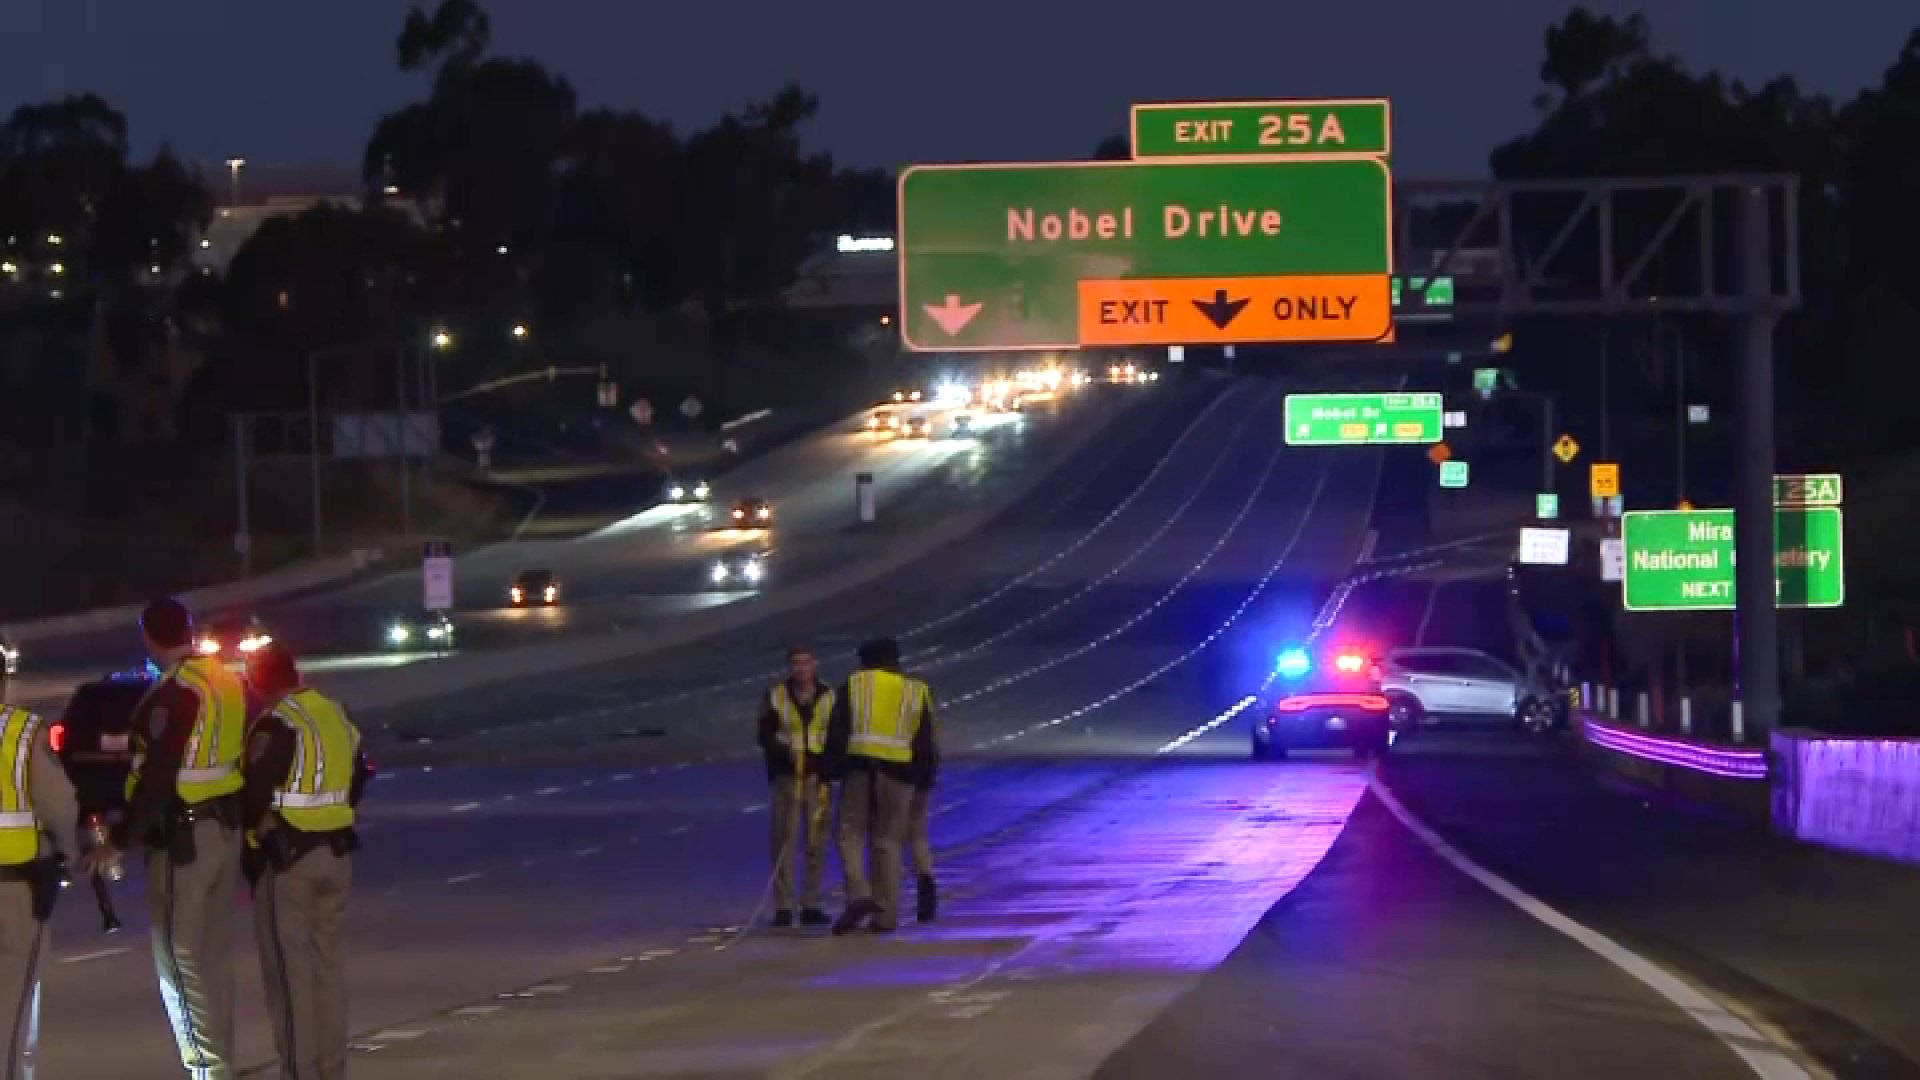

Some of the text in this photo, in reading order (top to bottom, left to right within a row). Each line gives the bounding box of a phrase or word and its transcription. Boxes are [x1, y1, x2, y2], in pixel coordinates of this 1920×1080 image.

[1175, 114, 1345, 145] EXIT 25A
[1007, 204, 1282, 241] Nobel Drive
[1099, 297, 1358, 324] EXIT ONLY
[1788, 479, 1836, 500] 25A
[1689, 521, 1733, 541] Mira
[1633, 549, 1718, 571] National
[1682, 579, 1731, 598] NEXT
